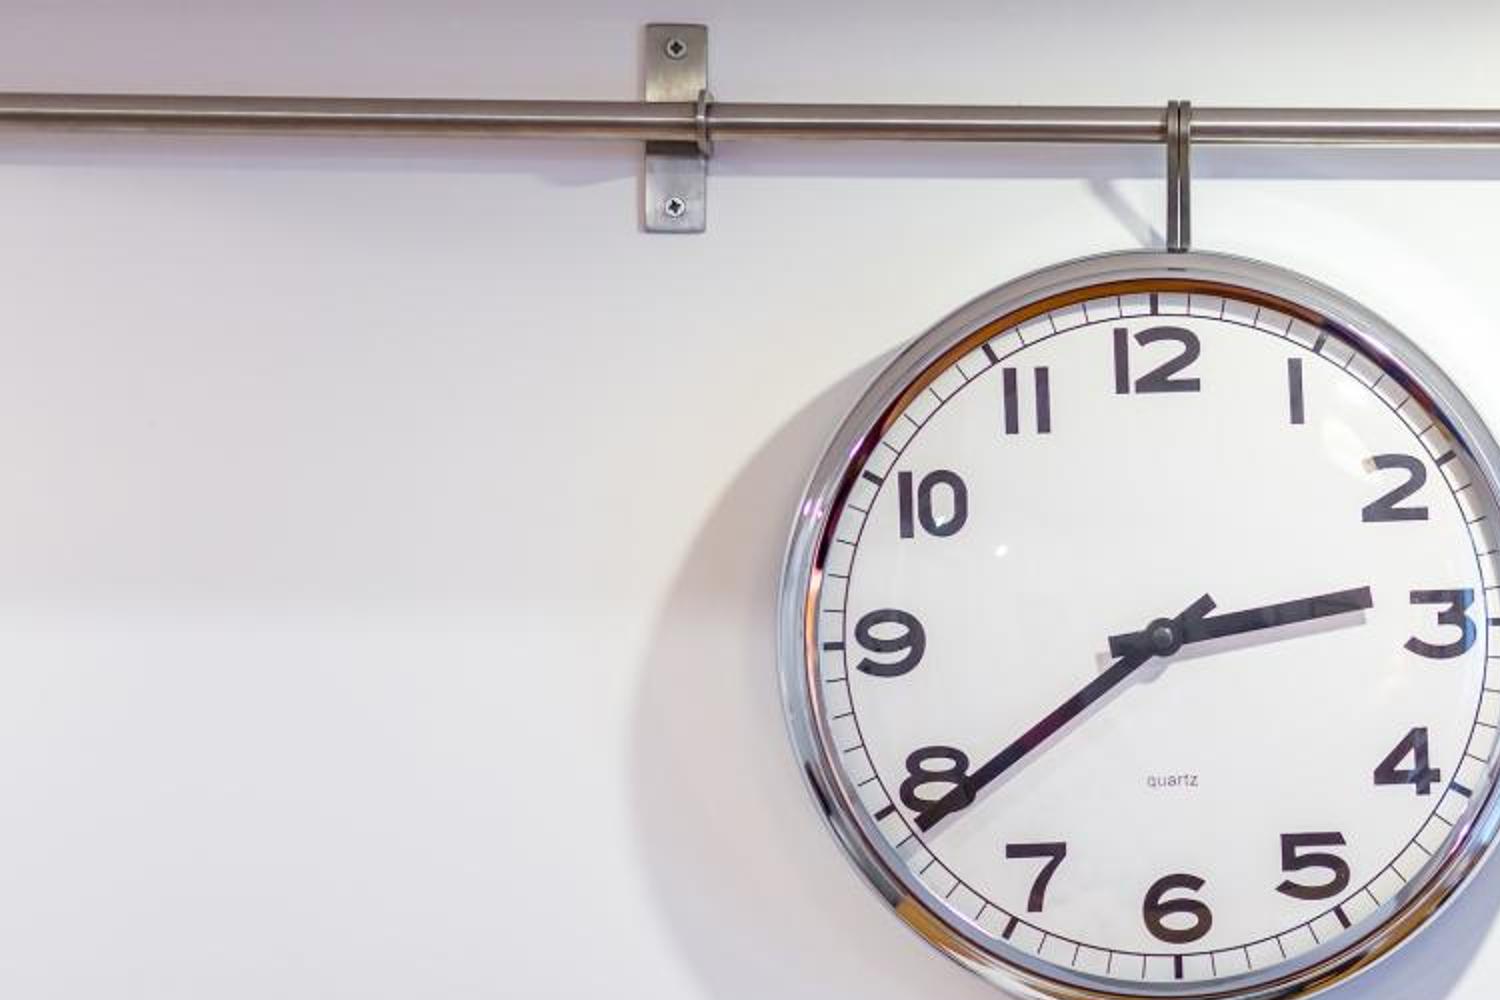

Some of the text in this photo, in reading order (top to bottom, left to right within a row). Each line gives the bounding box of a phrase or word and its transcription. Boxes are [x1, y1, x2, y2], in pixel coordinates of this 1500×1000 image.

[1113, 326, 1201, 395] 12
[1287, 357, 1305, 425] 1
[1002, 366, 1051, 435] 11
[898, 469, 968, 539] 10
[1362, 453, 1429, 523] 2
[854, 608, 926, 678] 9
[1403, 588, 1477, 660] 3
[898, 745, 977, 814] 8
[1146, 771, 1199, 791] quartz
[1373, 727, 1441, 795] 4
[1004, 841, 1067, 913] 7
[1275, 831, 1351, 900] 5
[1142, 873, 1213, 945] 6
